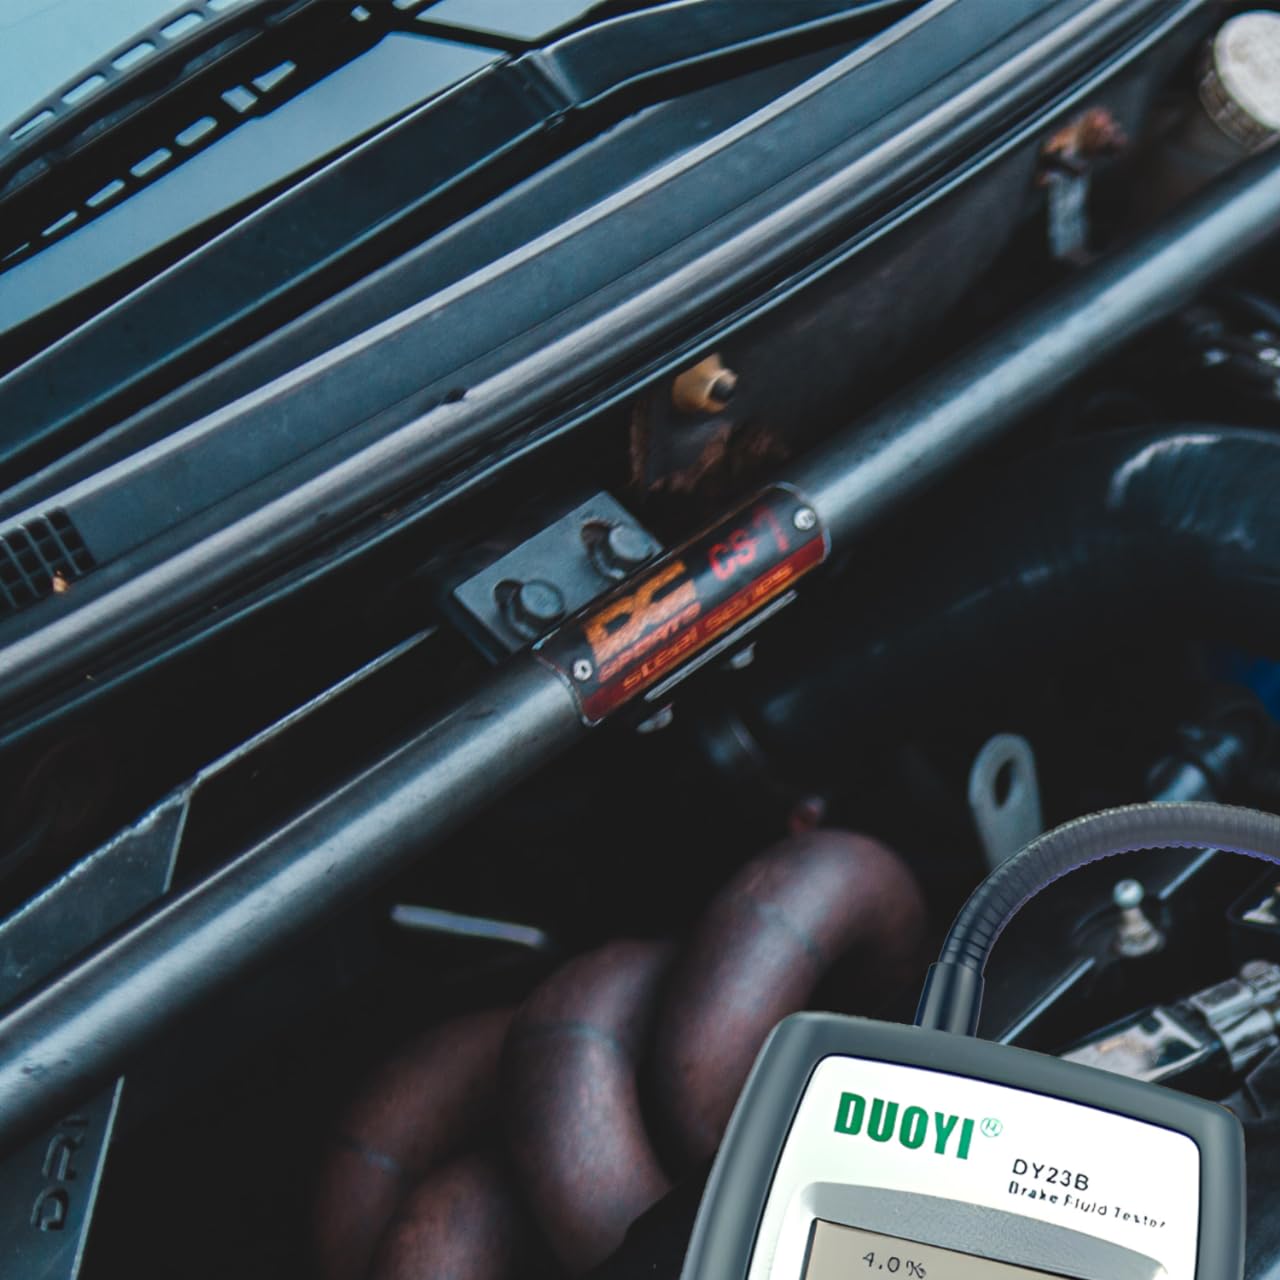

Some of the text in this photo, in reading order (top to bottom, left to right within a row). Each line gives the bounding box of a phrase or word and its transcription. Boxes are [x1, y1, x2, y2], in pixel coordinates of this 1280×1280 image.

[1012, 1158, 1090, 1191] DY23B
[1008, 1181, 1166, 1229] Brake Fluid Tester
[862, 1252, 926, 1279] 4.0%
